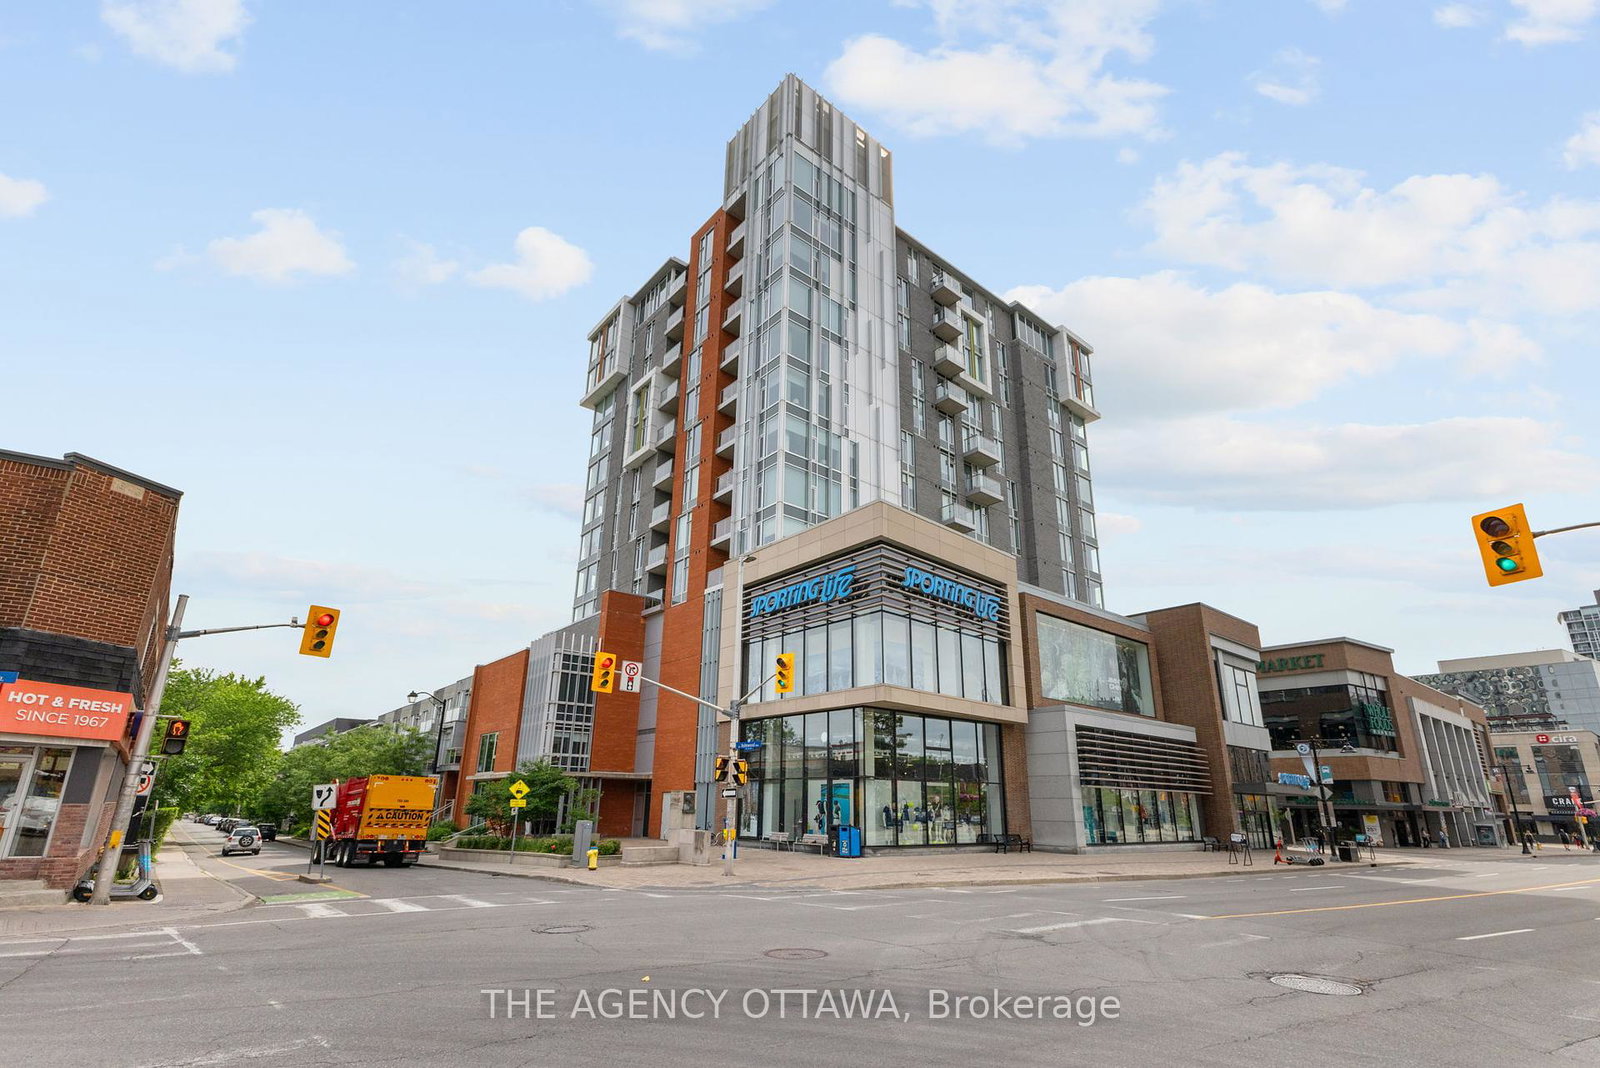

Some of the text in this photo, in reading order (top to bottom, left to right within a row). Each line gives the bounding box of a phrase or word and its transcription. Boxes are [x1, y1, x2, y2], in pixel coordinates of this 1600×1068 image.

[7, 691, 123, 714] HOT & FRESH
[1365, 703, 1392, 719] WHOLE
[15, 709, 109, 728] SINCE 1967
[1370, 717, 1395, 730] FOODS
[1551, 734, 1577, 743] cira
[385, 812, 424, 820] CAUTION
